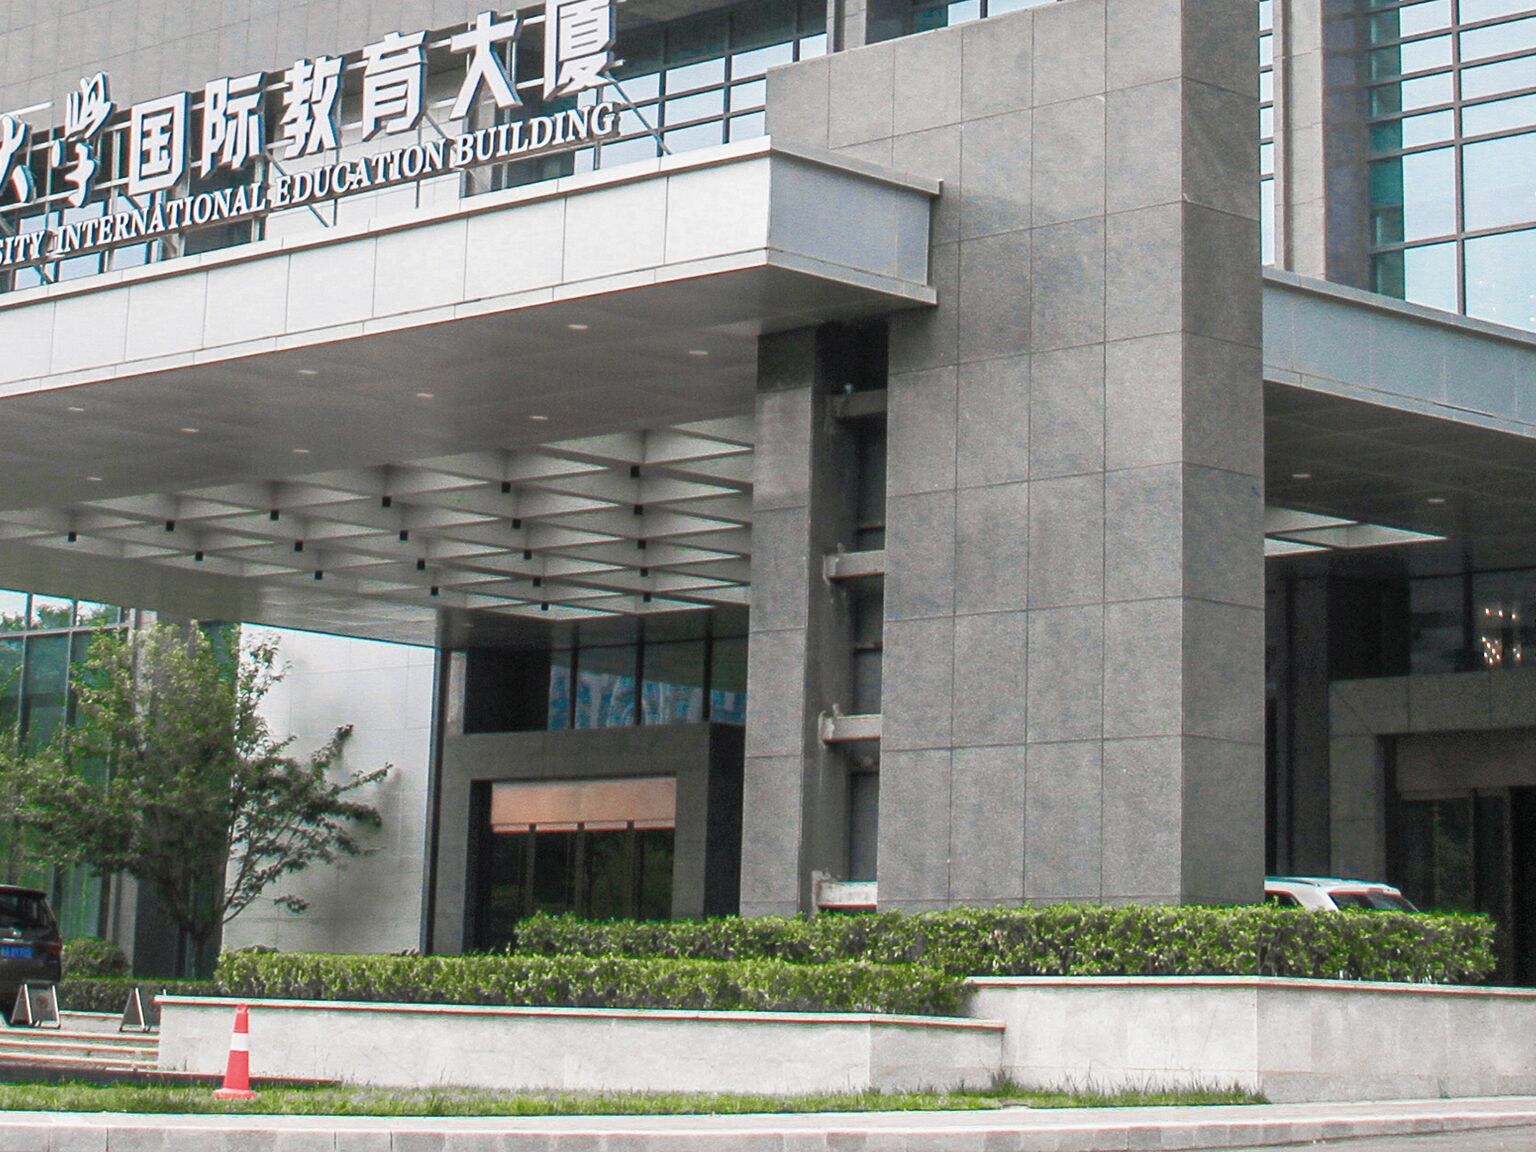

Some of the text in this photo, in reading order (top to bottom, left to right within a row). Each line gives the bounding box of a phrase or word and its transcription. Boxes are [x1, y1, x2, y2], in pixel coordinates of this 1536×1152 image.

[55, 181, 266, 253] INTERNATIONAL
[272, 138, 446, 208] EDUCATION
[454, 102, 615, 166] BUILDING
